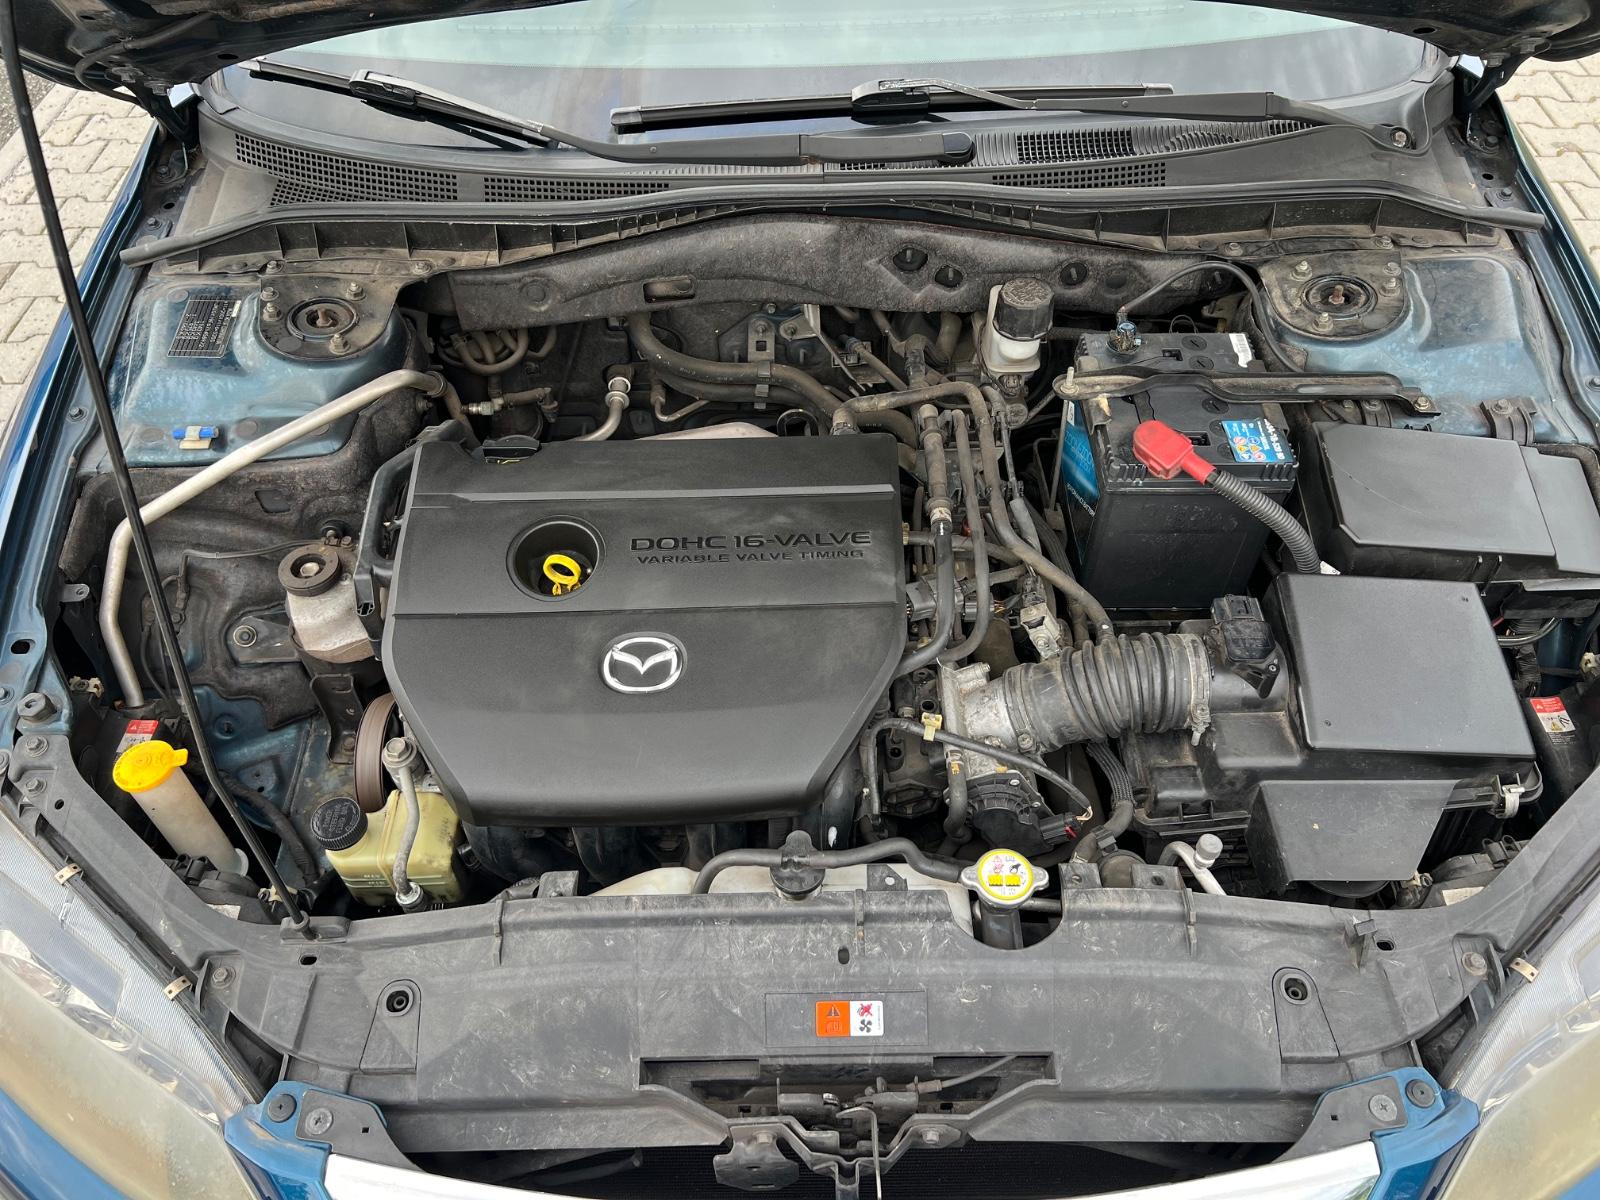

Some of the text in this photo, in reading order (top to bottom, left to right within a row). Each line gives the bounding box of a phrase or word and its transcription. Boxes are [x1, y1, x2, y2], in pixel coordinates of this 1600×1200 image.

[631, 531, 871, 551] DOHC 16-VALVE
[637, 549, 864, 564] VARIABLE VALVE TIMING
